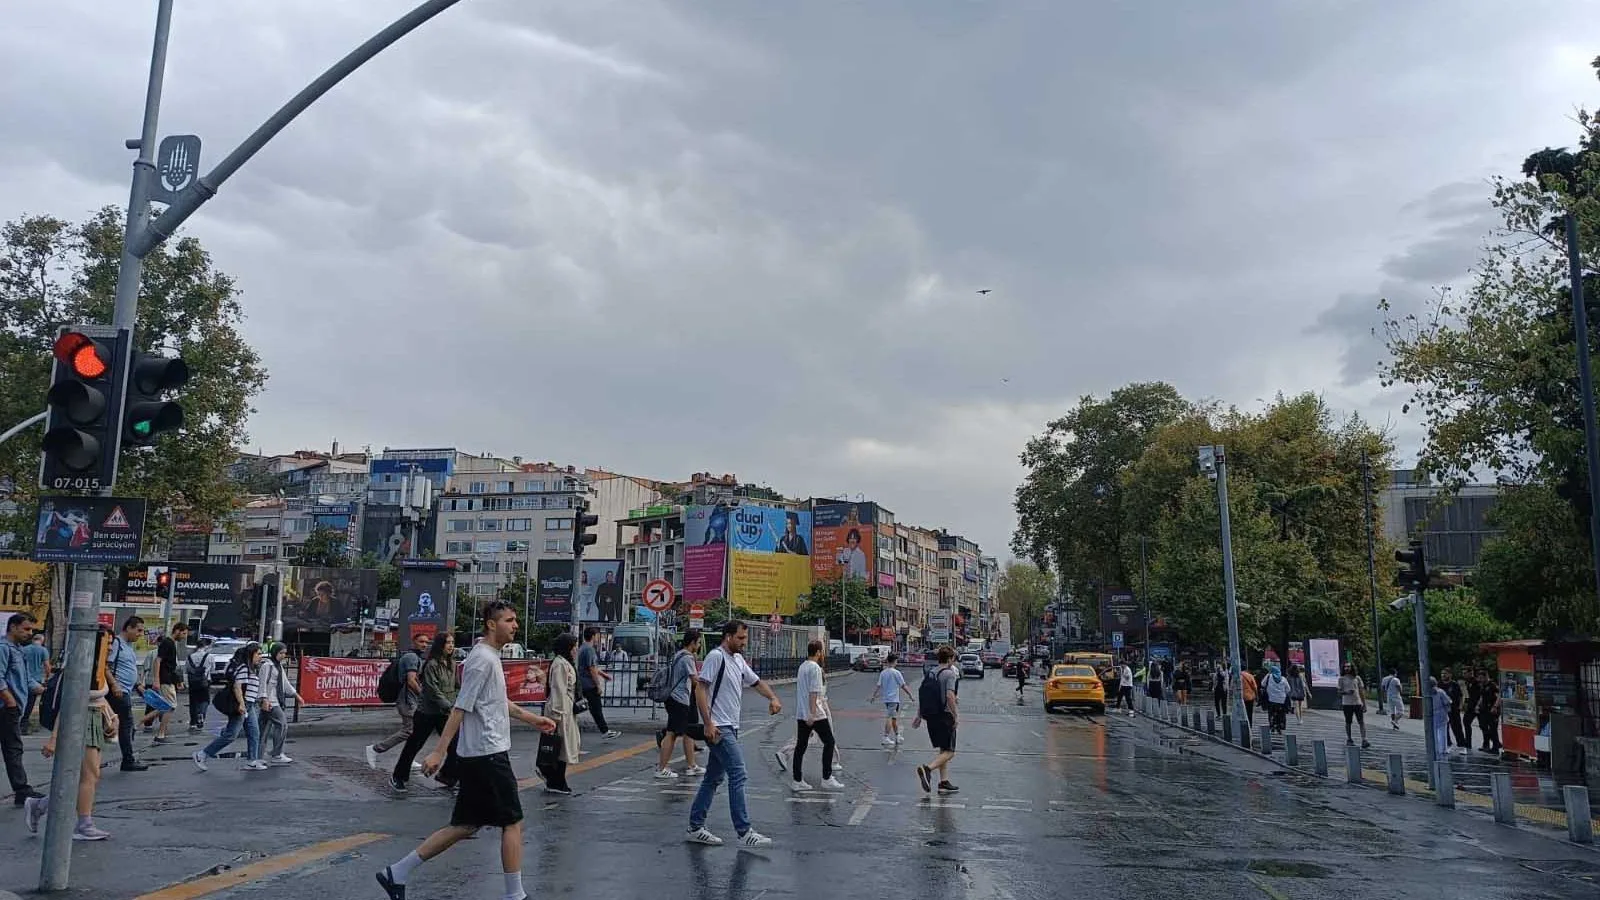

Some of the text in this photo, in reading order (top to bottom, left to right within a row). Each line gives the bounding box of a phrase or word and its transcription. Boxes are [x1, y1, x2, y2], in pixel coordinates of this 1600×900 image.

[54, 477, 100, 489] 07-015
[735, 508, 764, 525] dual
[93, 531, 137, 541] Ben duyarlı
[741, 524, 758, 539] up
[91, 541, 136, 550] sürücüyüm
[176, 581, 230, 591] DAYANIŞMA
[340, 687, 379, 699] BULUŞAL
